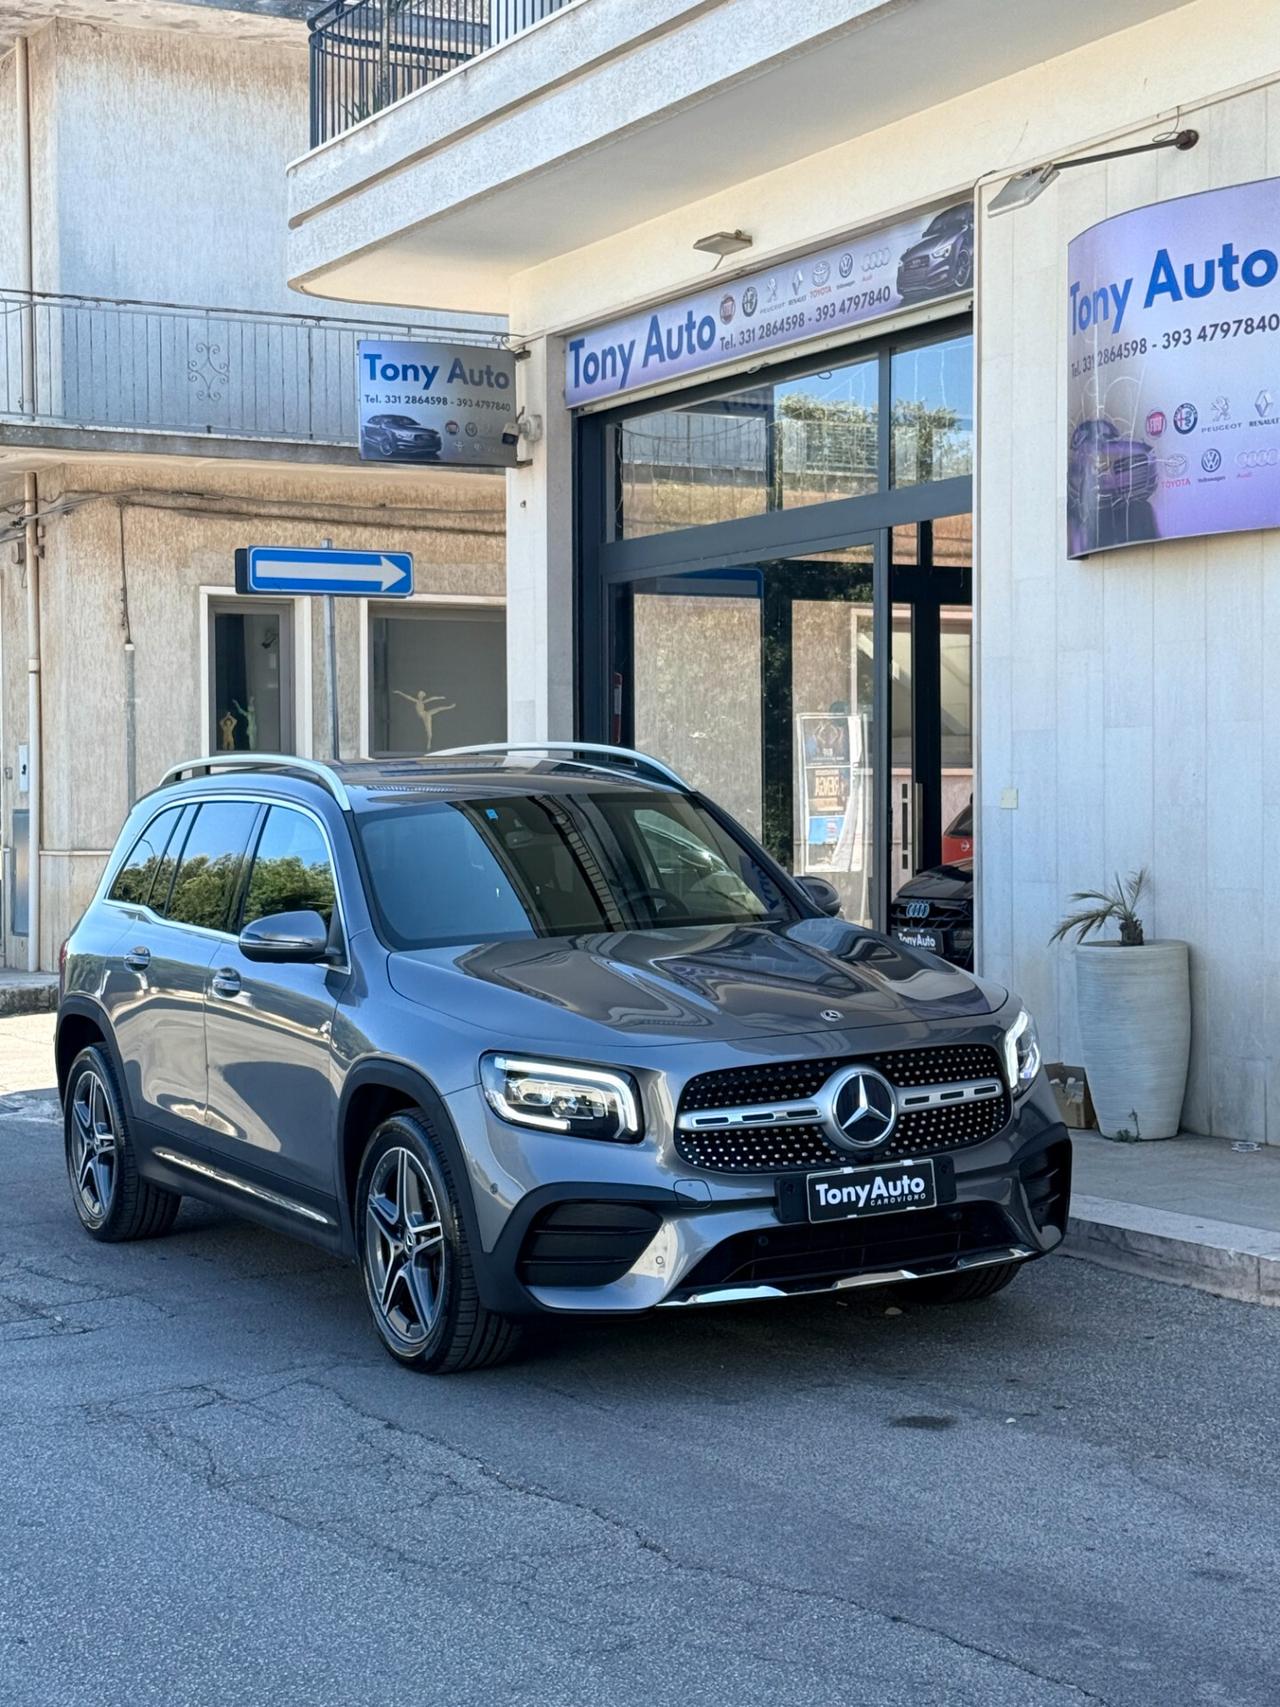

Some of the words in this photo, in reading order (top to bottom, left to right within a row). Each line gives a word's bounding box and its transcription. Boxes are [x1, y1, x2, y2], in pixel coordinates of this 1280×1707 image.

[809, 286, 832, 299] TOYOTA
[1070, 277, 1134, 335] Tony
[1143, 242, 1278, 309] Auto
[720, 335, 736, 352] Tel.
[739, 326, 756, 347] 331
[758, 313, 805, 340] 2864598
[815, 302, 836, 324] 393
[838, 285, 892, 319] 4797840
[569, 337, 636, 389] Tony
[642, 309, 716, 368] Auto
[1082, 353, 1096, 373] 331
[1097, 337, 1147, 367] 2864598
[1161, 328, 1192, 350] 393
[1196, 313, 1280, 344] 4797840
[363, 353, 440, 390] Tony
[446, 357, 510, 389] Auto
[364, 394, 382, 404] Tel.
[384, 395, 402, 404] 331
[405, 395, 448, 406] 2864598
[456, 398, 474, 407] 393
[475, 401, 511, 412] 4797840
[1201, 422, 1243, 433] PEUGEOT
[1161, 478, 1191, 488] TOYOTA
[815, 1175, 925, 1207] TonyAuto
[870, 1192, 926, 1206] CAROVIGNO
